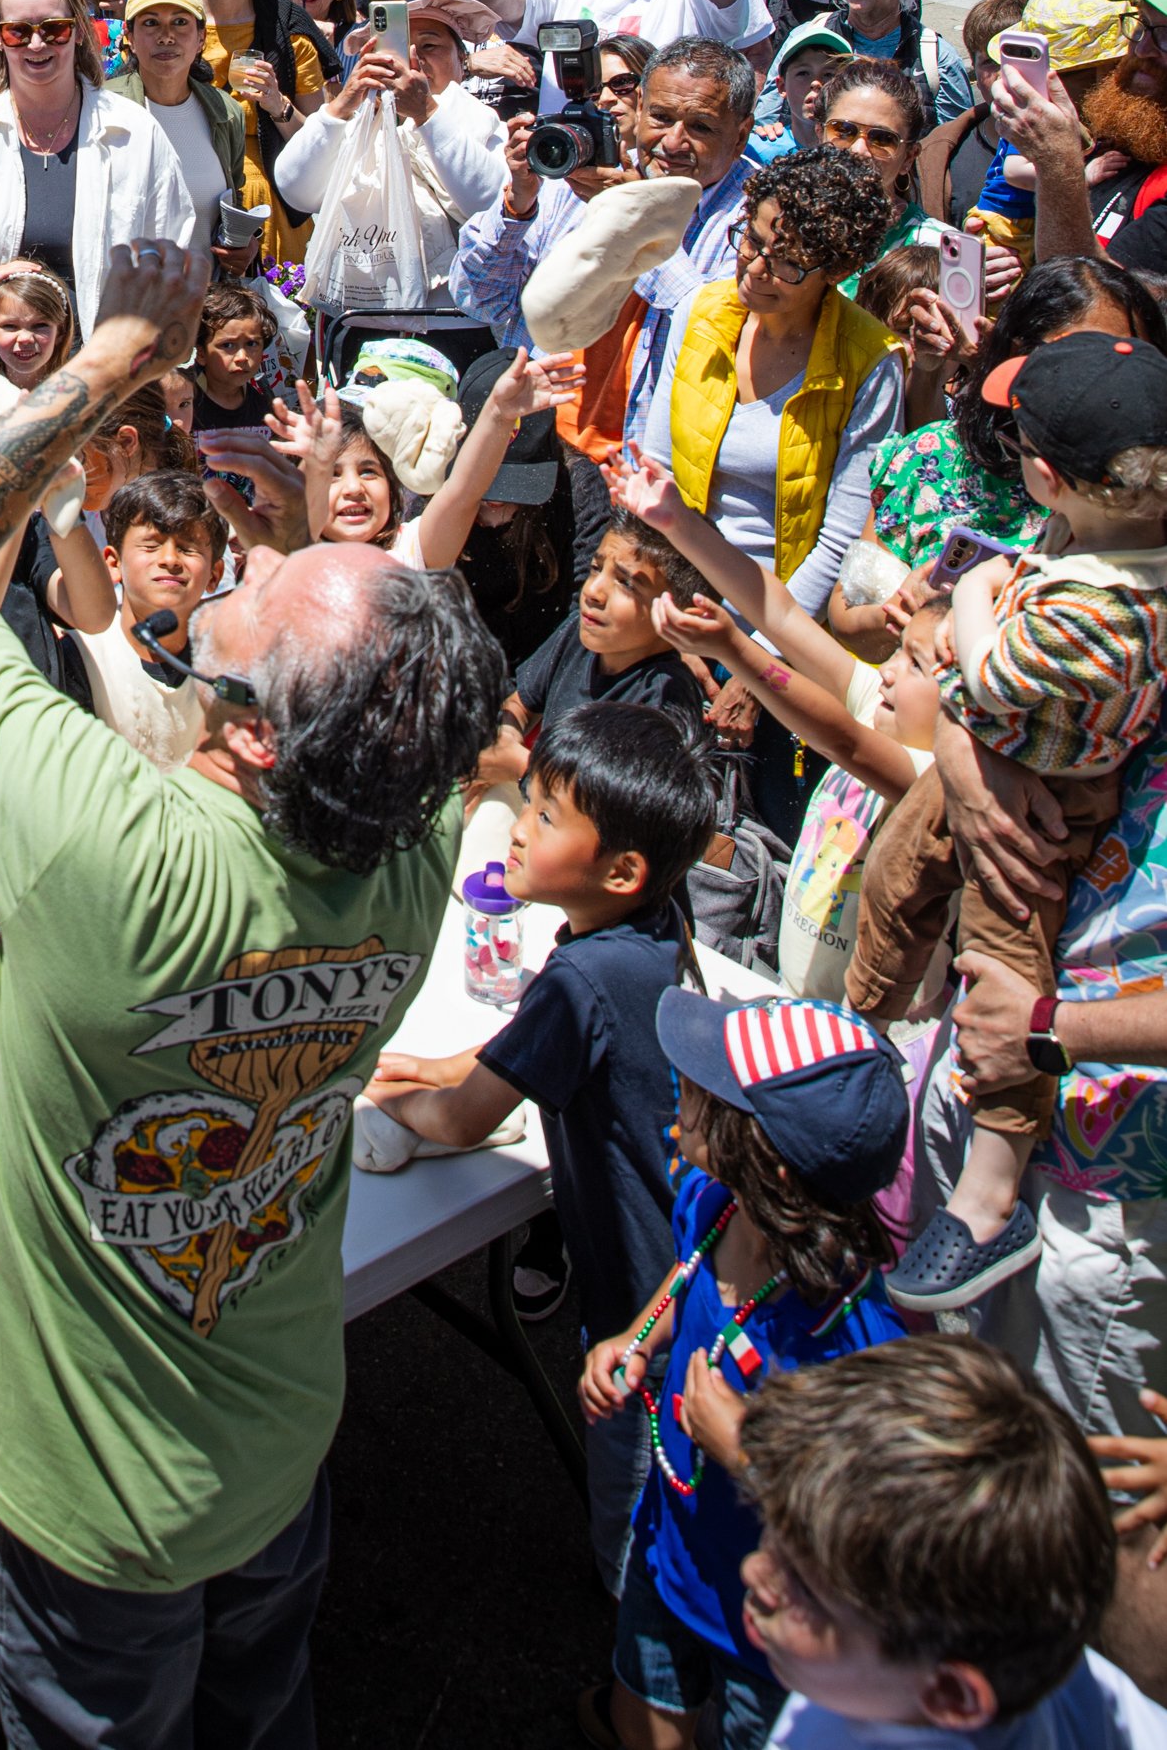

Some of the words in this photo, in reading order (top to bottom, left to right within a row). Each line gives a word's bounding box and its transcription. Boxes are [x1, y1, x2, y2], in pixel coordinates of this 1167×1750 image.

[362, 223, 397, 255] You
[343, 253, 364, 264] PING
[793, 911, 849, 952] REGION
[190, 957, 411, 1036] TONY'S
[318, 1003, 381, 1020] PIZZA
[216, 1030, 350, 1057] NAPOLETANA
[100, 1199, 156, 1239] EAT
[163, 1188, 243, 1236] YOUR
[241, 1130, 318, 1210] HEART
